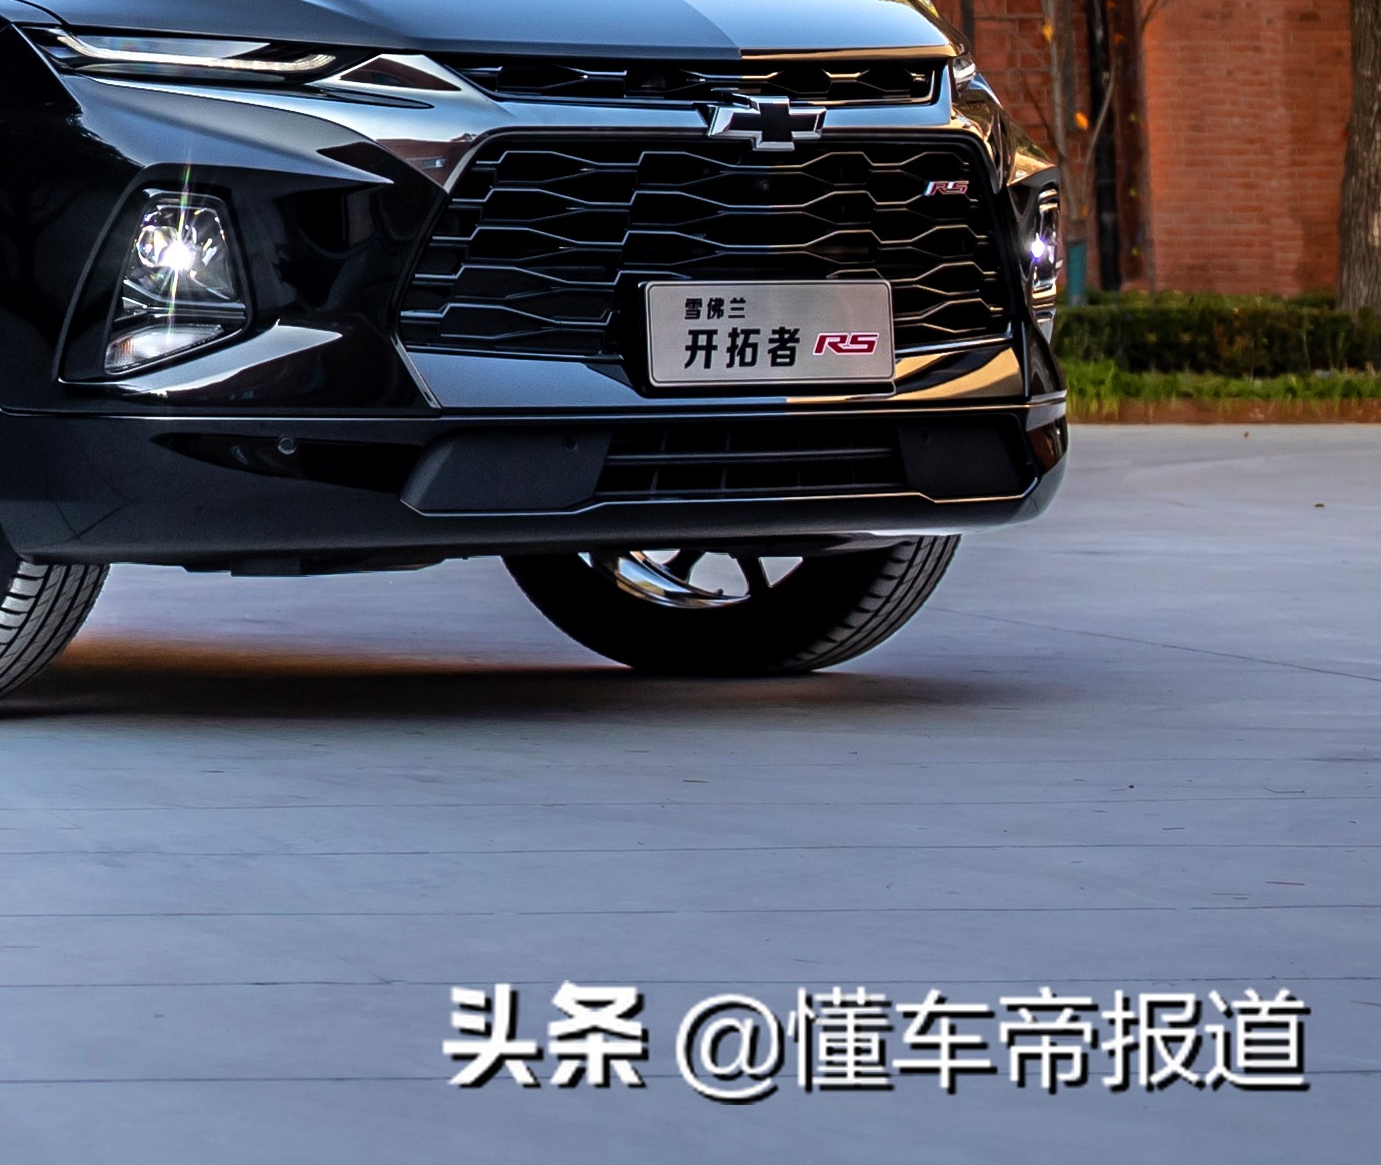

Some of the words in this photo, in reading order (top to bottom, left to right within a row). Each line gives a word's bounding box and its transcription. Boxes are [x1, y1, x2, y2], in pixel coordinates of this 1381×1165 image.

[927, 180, 969, 196] RS
[684, 297, 746, 320] 雪佛兰
[684, 326, 800, 369] 开拓者
[812, 332, 880, 355] RS
